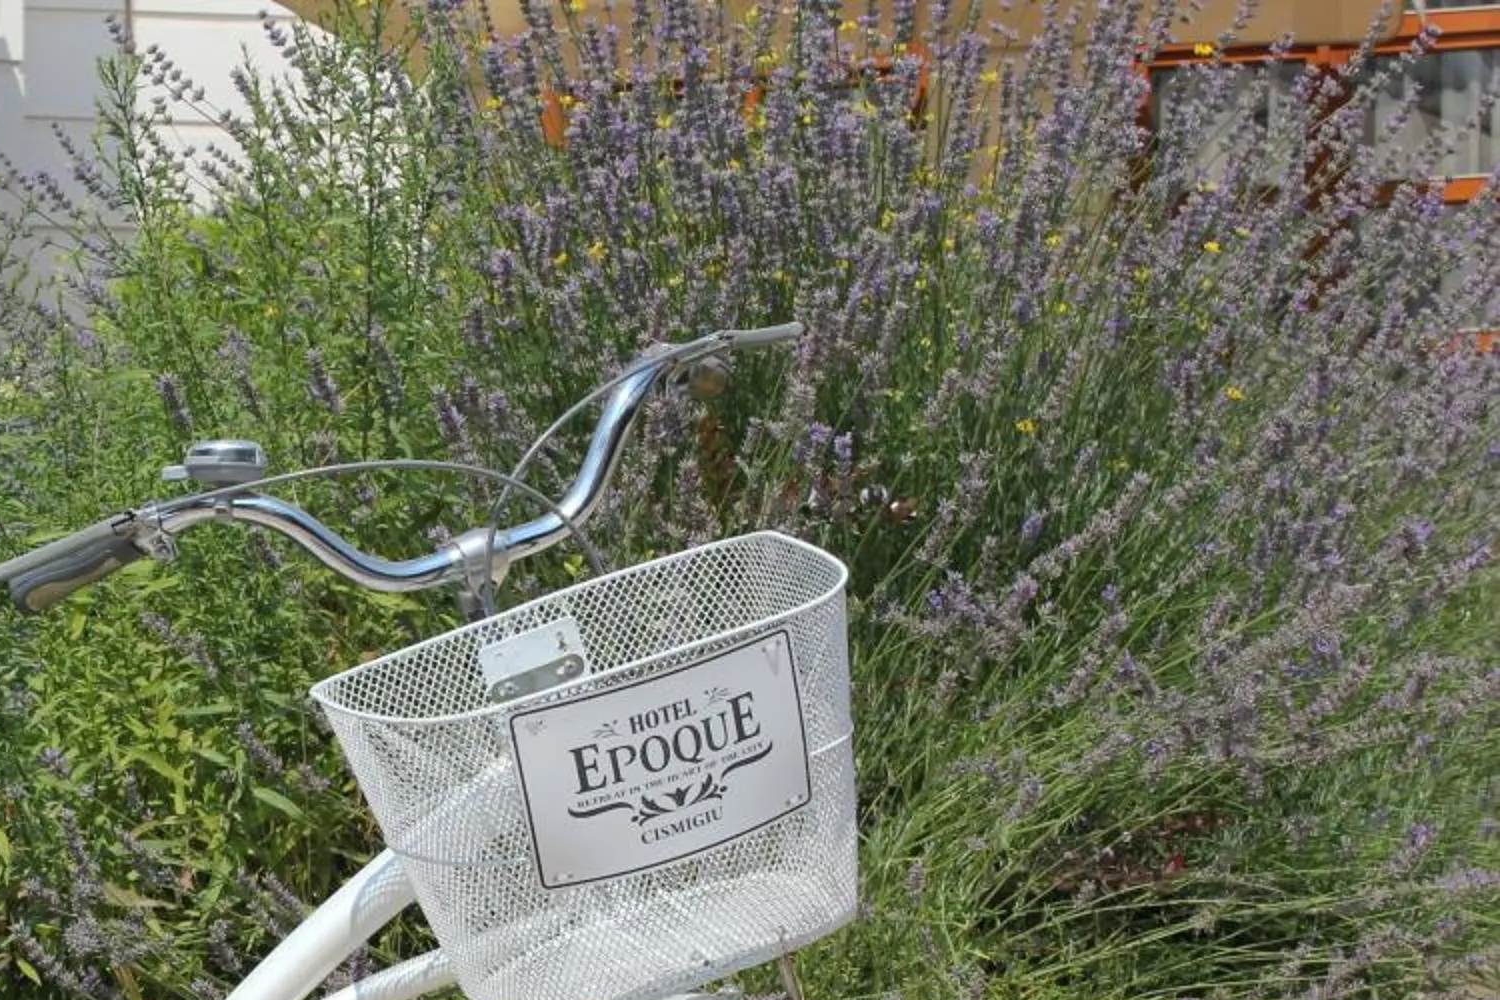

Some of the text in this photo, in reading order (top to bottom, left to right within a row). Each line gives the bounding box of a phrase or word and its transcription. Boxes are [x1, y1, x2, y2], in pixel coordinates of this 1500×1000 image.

[629, 698, 697, 734] HOTEL
[569, 691, 761, 794] EPOQUE
[641, 805, 723, 845] CISMIGIU
